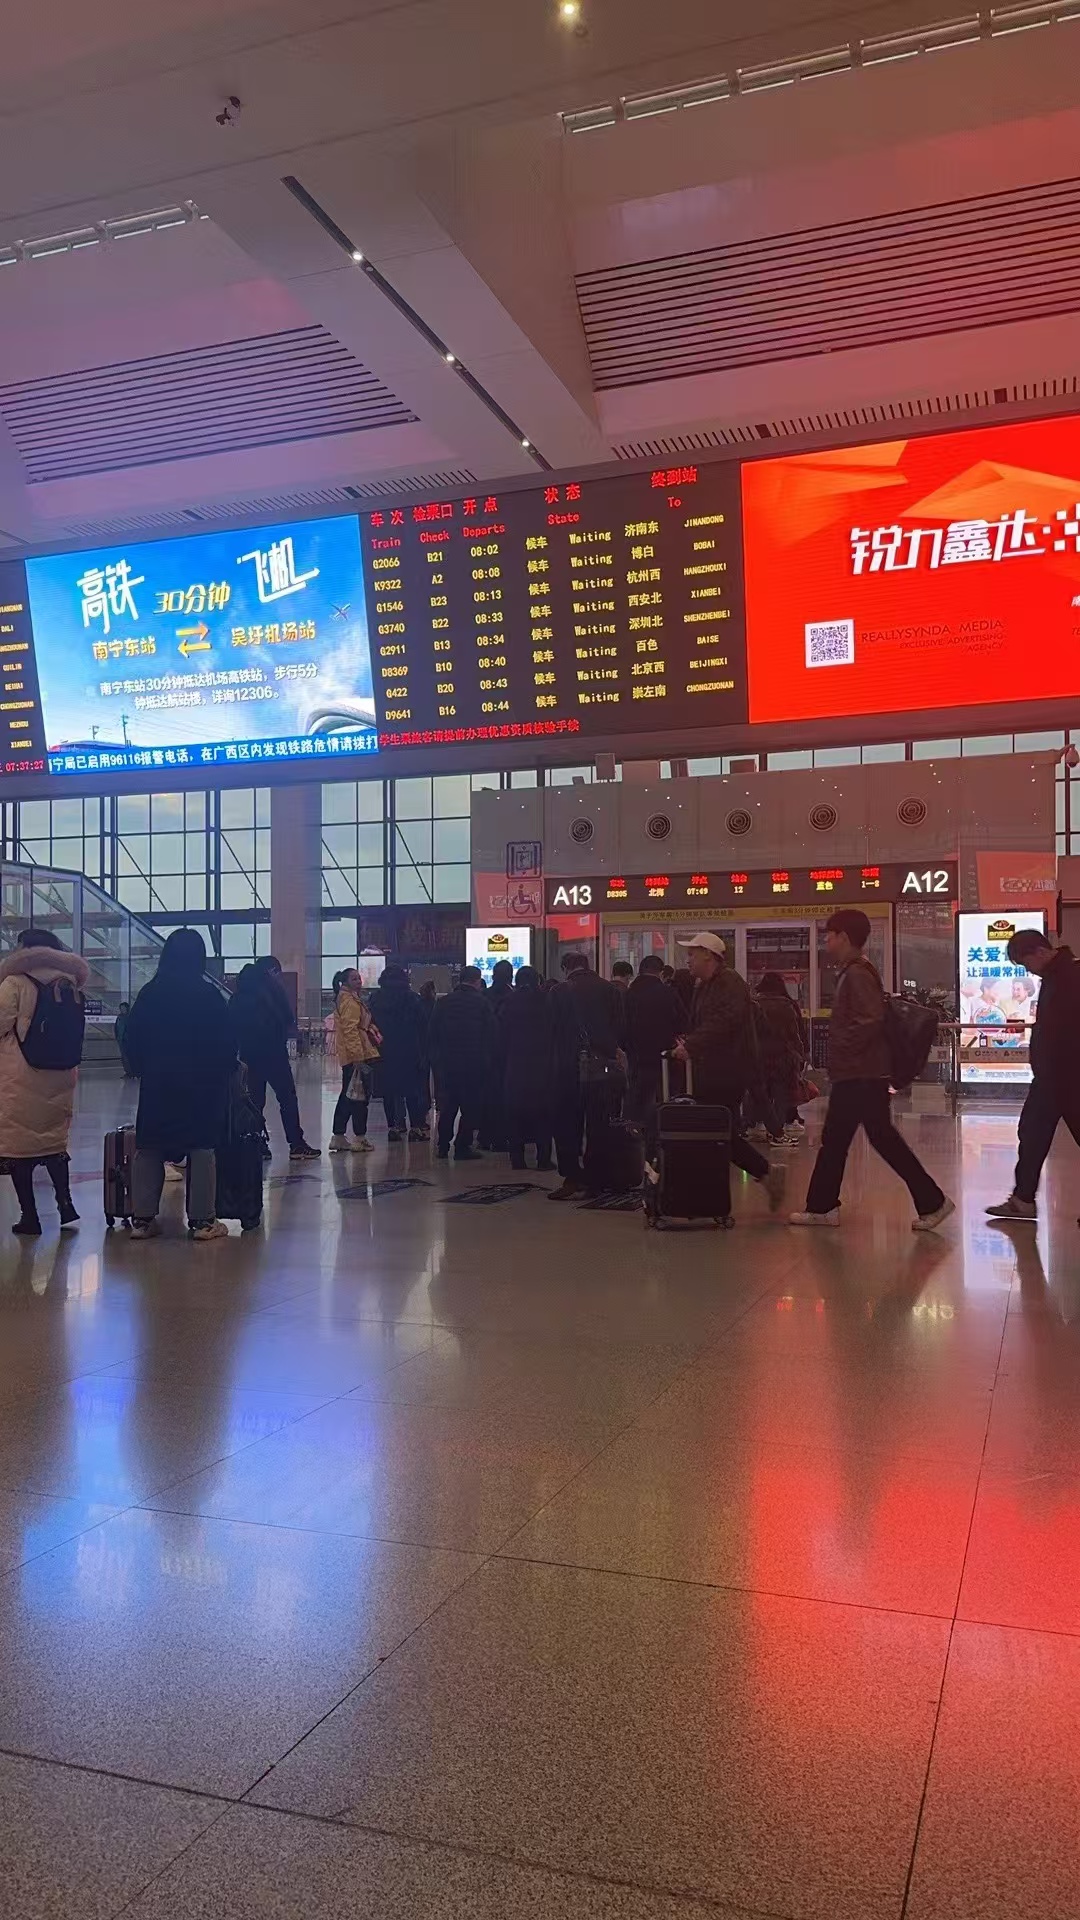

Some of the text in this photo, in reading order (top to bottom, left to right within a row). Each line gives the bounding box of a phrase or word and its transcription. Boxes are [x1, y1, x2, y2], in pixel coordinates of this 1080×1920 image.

[412, 503, 453, 523] 检票口
[650, 466, 698, 488] 终到站
[371, 496, 682, 549] Train Check Departs State To
[372, 514, 725, 570] G2066 B21 08:02 候车 Waiting 济南东 JINANDONG
[76, 536, 321, 635] 高铁 30分钟 飞机
[374, 539, 715, 591] K9322 A2 08:08 候车 Waiting 博白 BOBAI
[376, 562, 727, 613] G1546 B23 08:13 候车 Waiting 杭州西 HANGZHOUXI
[378, 586, 721, 635] G3740 B22 08:33 候车 Waiting 西安北 XIANBEI
[91, 619, 316, 660] 南宁东站 吴圩机场站
[379, 609, 731, 657] G2911 B13 08:34 候车 Waiting 深圳北 SHENZHENBEI
[861, 620, 1004, 644] REALLYSYNDA MEDIA
[899, 633, 1004, 650] EXCLUSIVE ADVERTISING
[966, 642, 1004, 654] AGENCY
[381, 634, 720, 678] D8369 B10 08:40 候车 Waiting 百色 BAISE
[385, 656, 728, 699] G422 B20 08:43 候车 Waiting 北京西 BEIJINGXI
[384, 680, 735, 721] D9641 B16 08:44 候车 Waiting 崇左南 CHONGZUONAN
[5, 760, 44, 772] 07:37:27
[552, 885, 592, 907] A13
[733, 885, 744, 894] 12
[901, 870, 949, 893] A12
[473, 956, 524, 971] 关爱辈
[967, 966, 1034, 978] 让温暖常相
